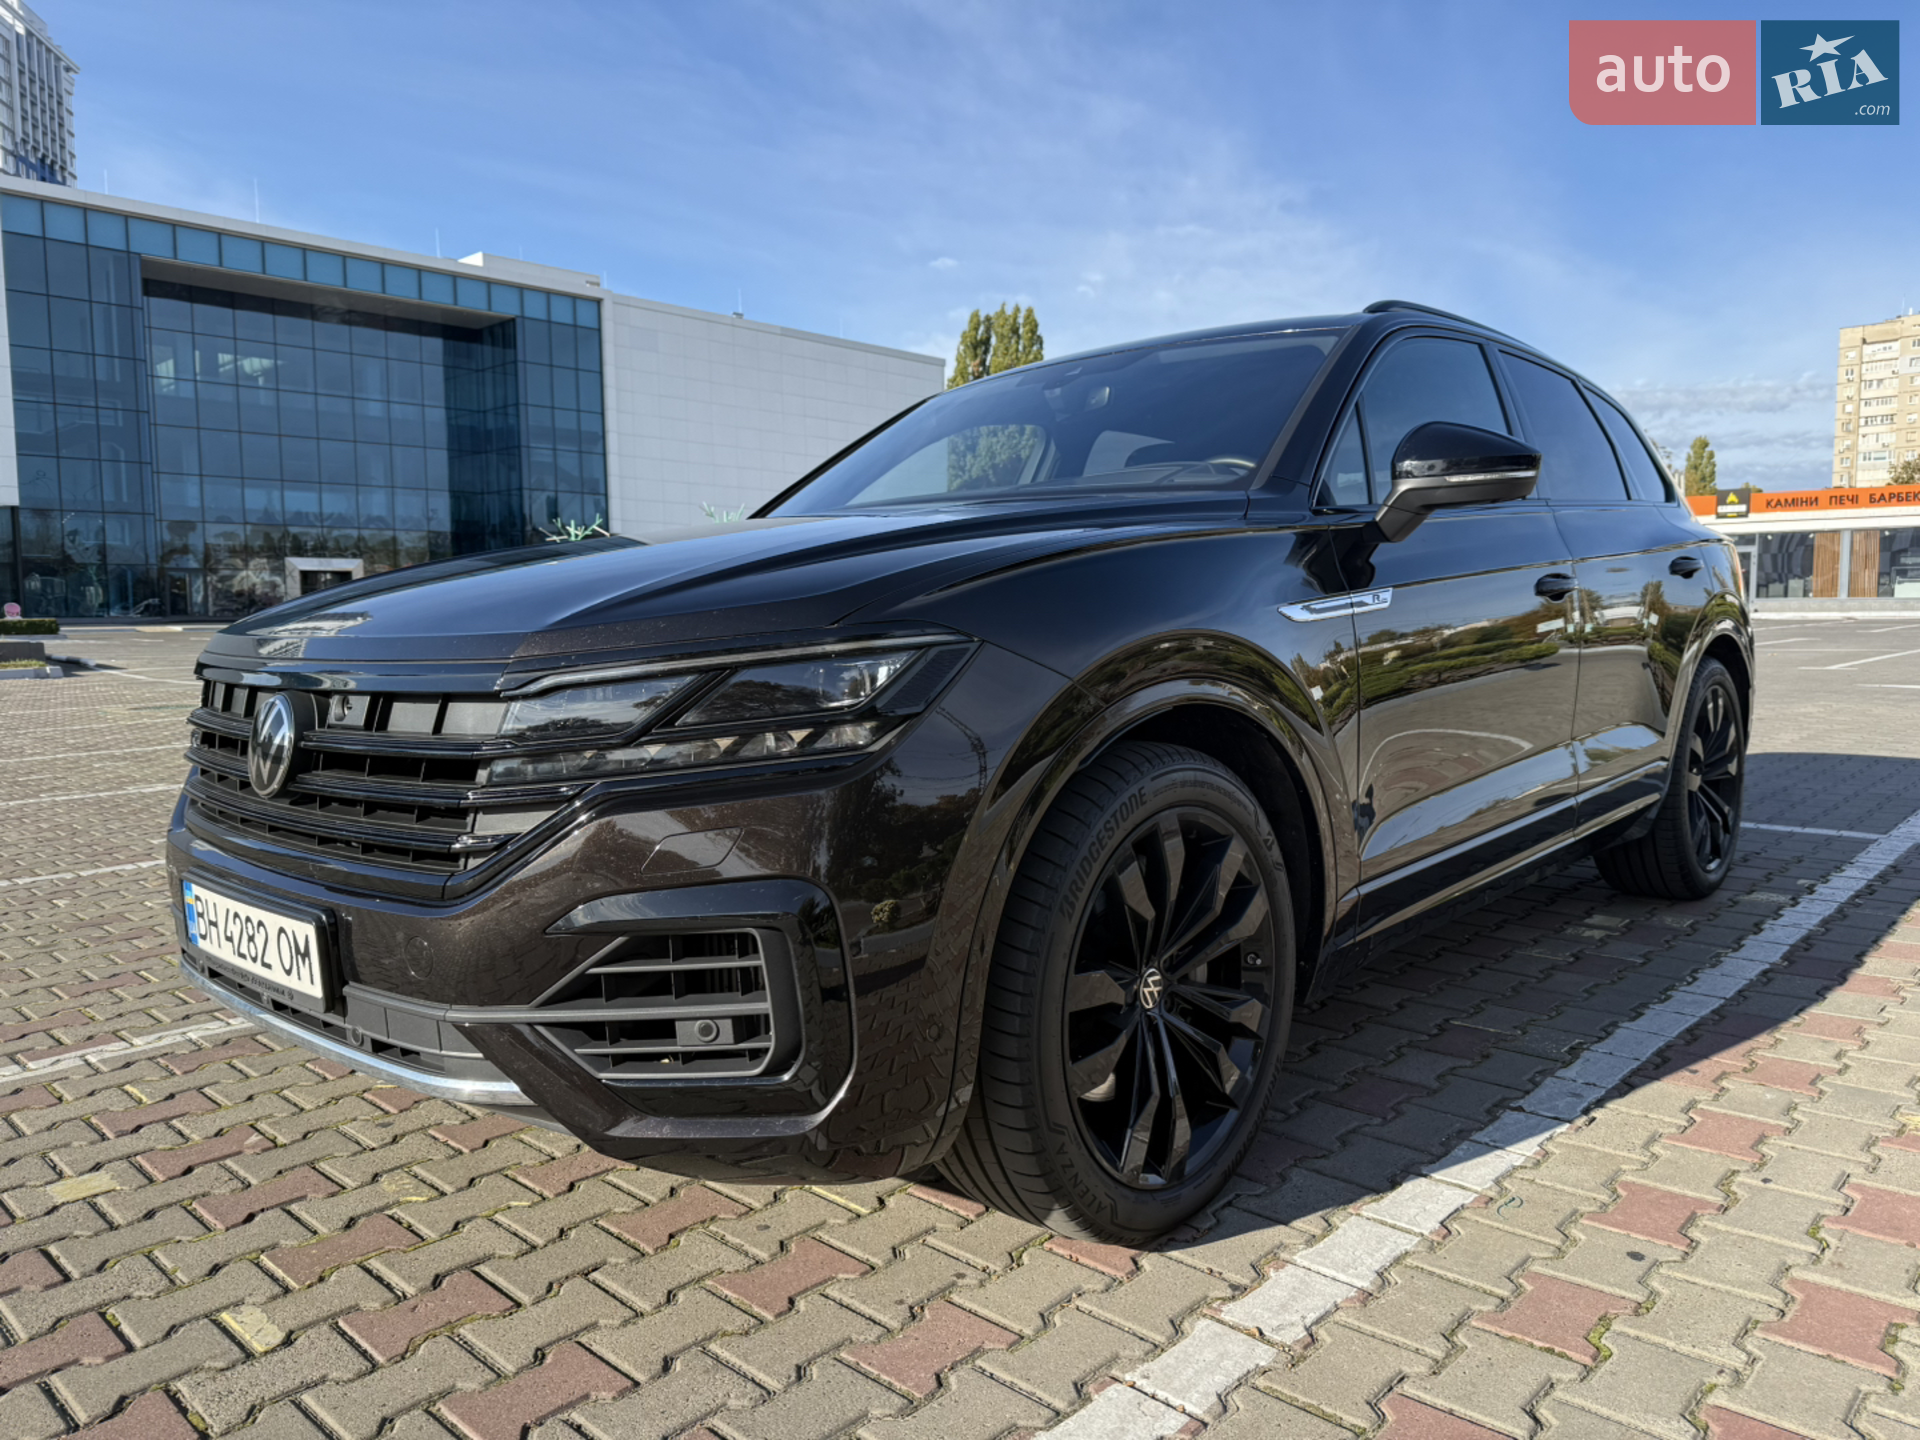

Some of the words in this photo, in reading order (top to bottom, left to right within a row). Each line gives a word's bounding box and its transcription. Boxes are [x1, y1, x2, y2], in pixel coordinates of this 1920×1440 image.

[1766, 496, 1819, 509] КАМІНИ
[1829, 493, 1859, 506] ПЕЧІ
[1059, 786, 1147, 923] BRIDGESTONE
[195, 894, 221, 949] BH
[224, 907, 272, 970] 4282
[277, 926, 315, 985] OM
[1055, 1142, 1108, 1213] ALENZA
